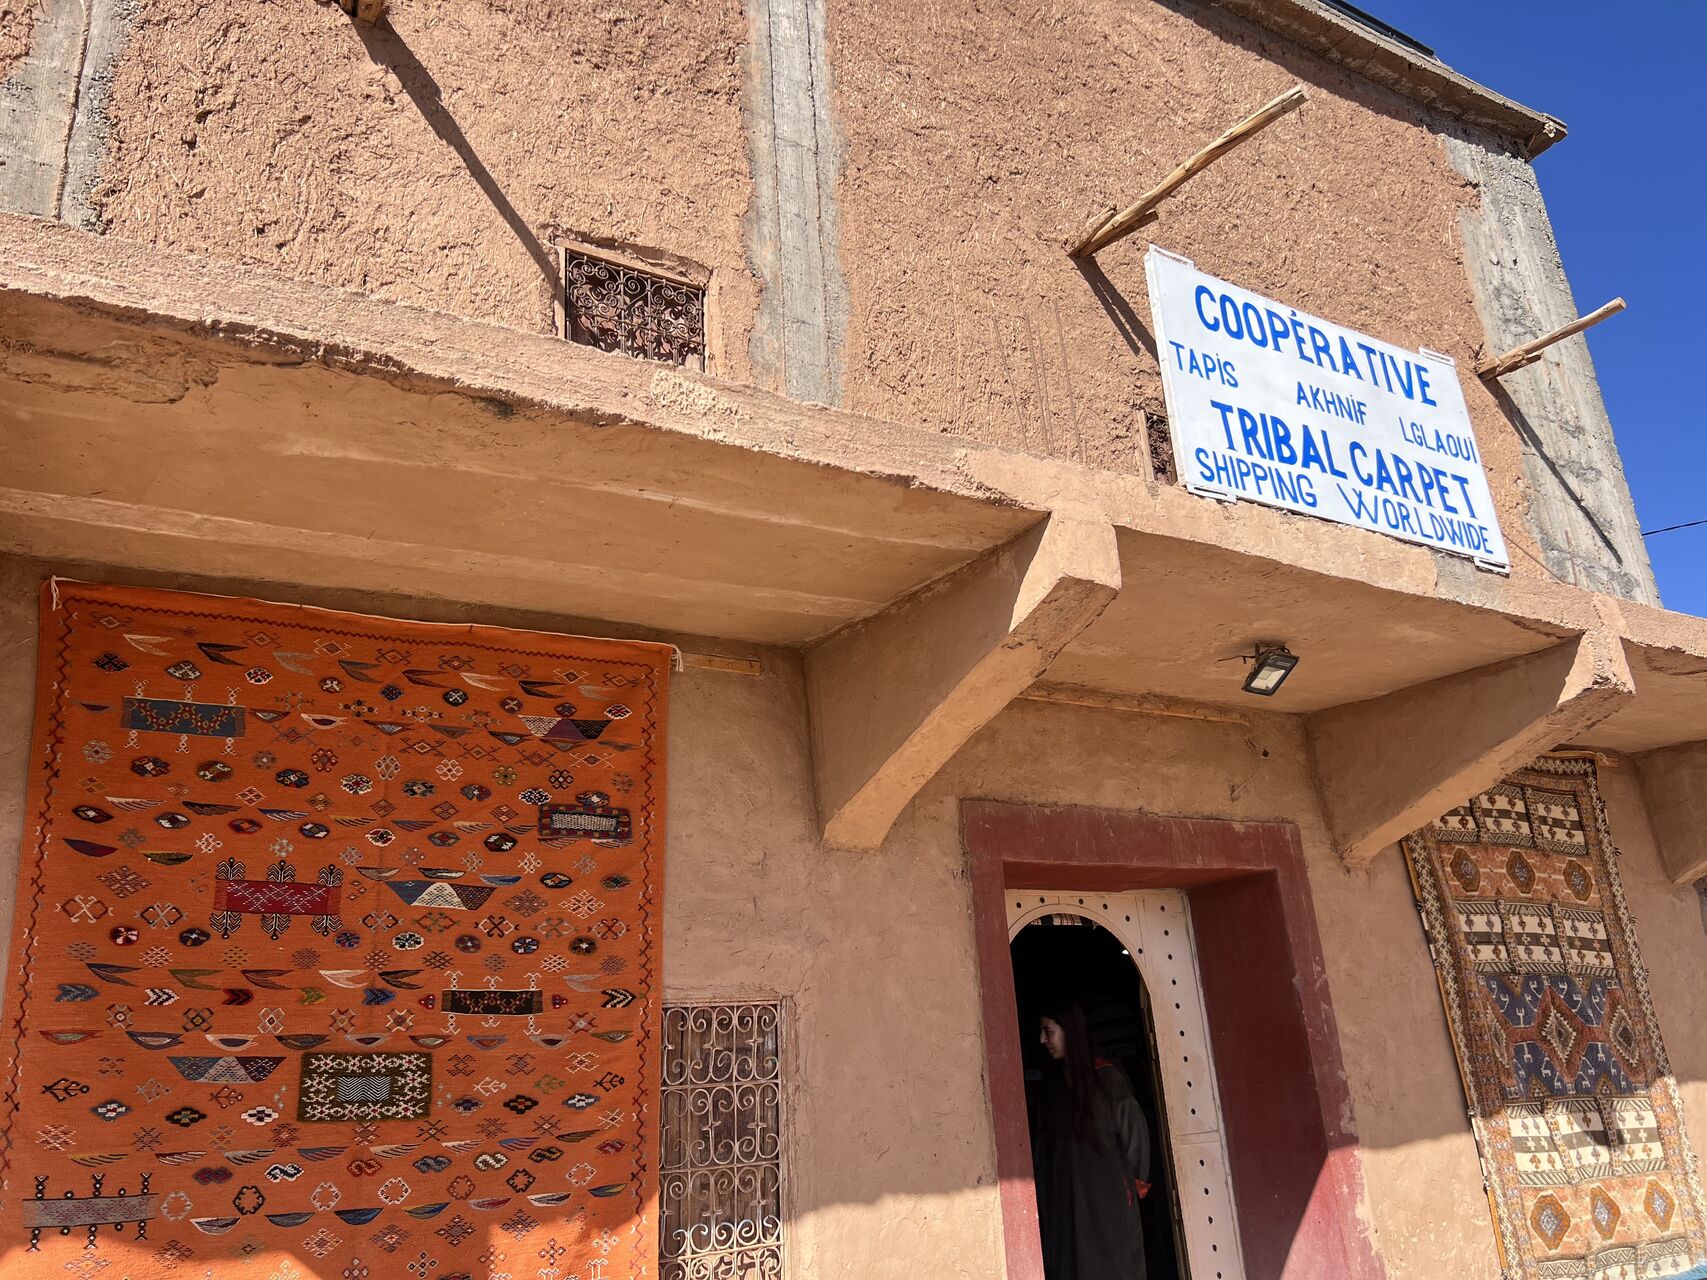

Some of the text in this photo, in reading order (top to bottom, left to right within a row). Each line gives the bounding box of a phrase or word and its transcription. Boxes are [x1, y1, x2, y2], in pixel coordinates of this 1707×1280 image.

[1195, 448, 1494, 554] SHIPPING WORLDWIDE
[1210, 400, 1478, 519] TRIBAL CARPET
